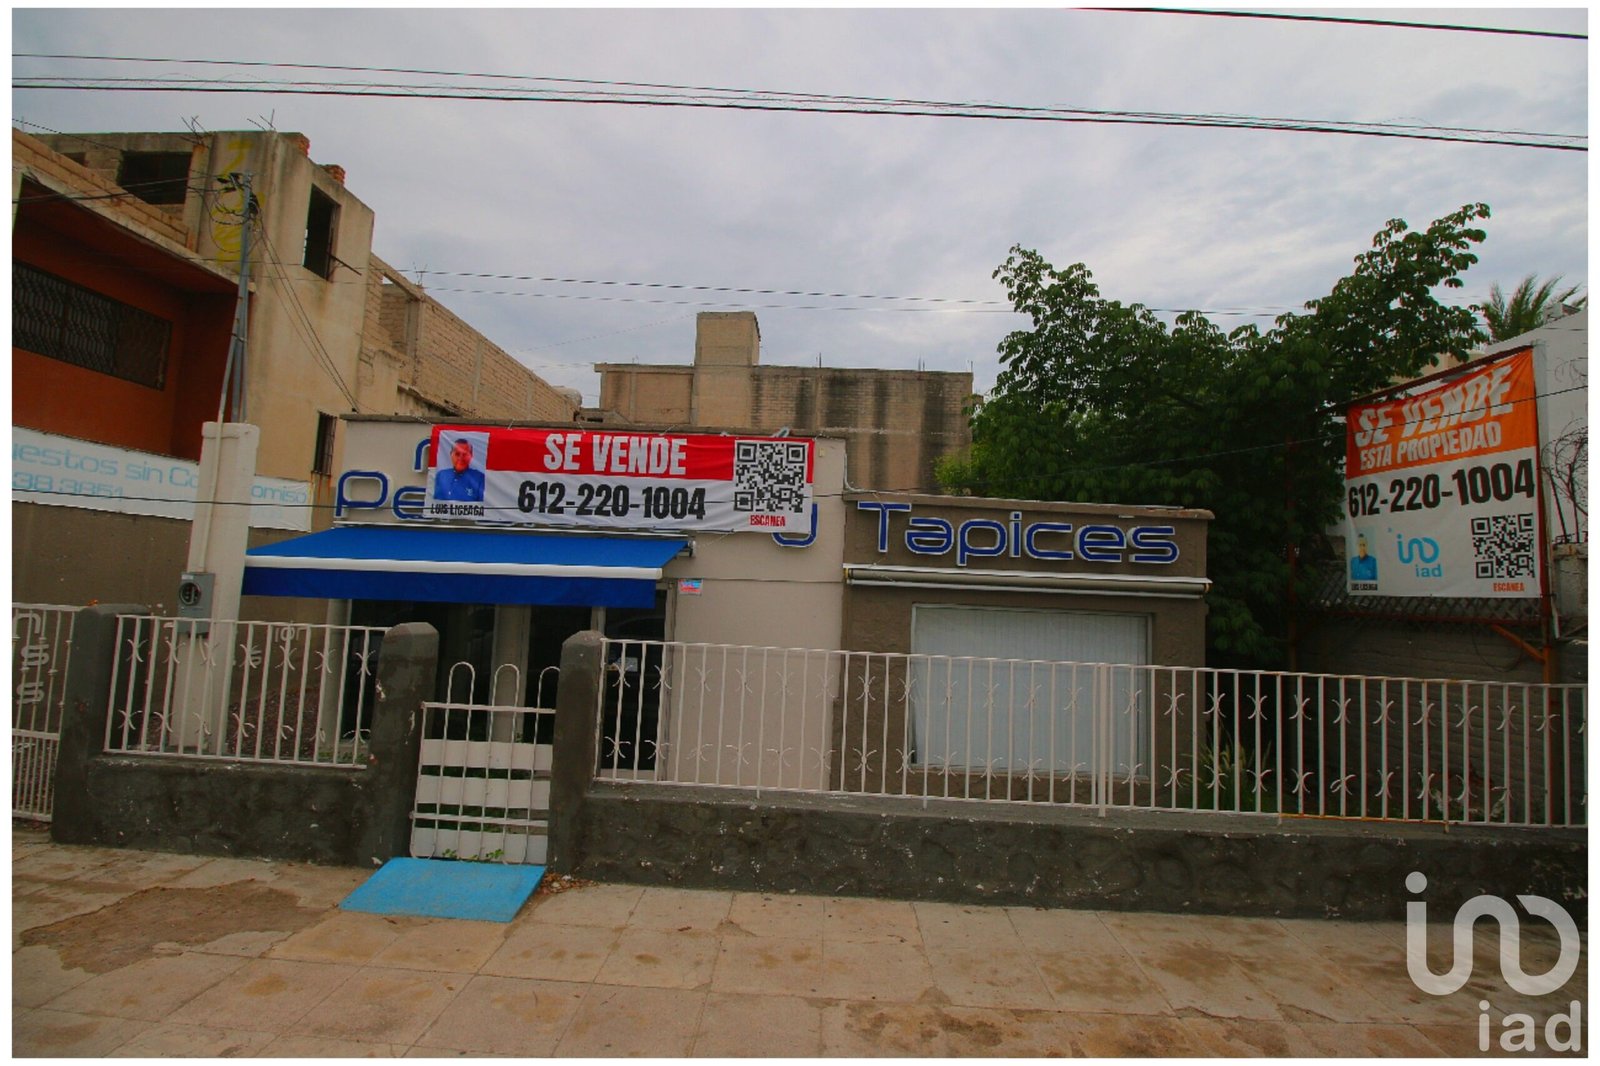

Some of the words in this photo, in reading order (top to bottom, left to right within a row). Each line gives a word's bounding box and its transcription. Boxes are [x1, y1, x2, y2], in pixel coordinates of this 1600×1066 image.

[1356, 406, 1393, 448] SE
[1401, 365, 1513, 439] VENDE
[543, 433, 582, 472] SE
[592, 434, 687, 475] VENDE
[1360, 443, 1393, 471] ESTA
[1396, 421, 1502, 464] PROPIEDAD
[518, 480, 706, 521] 612-220-1004
[1348, 458, 1535, 518] 612-220-1004
[750, 515, 786, 527] ESCANEA
[857, 501, 1180, 566] Tapices
[1415, 564, 1442, 579] iad
